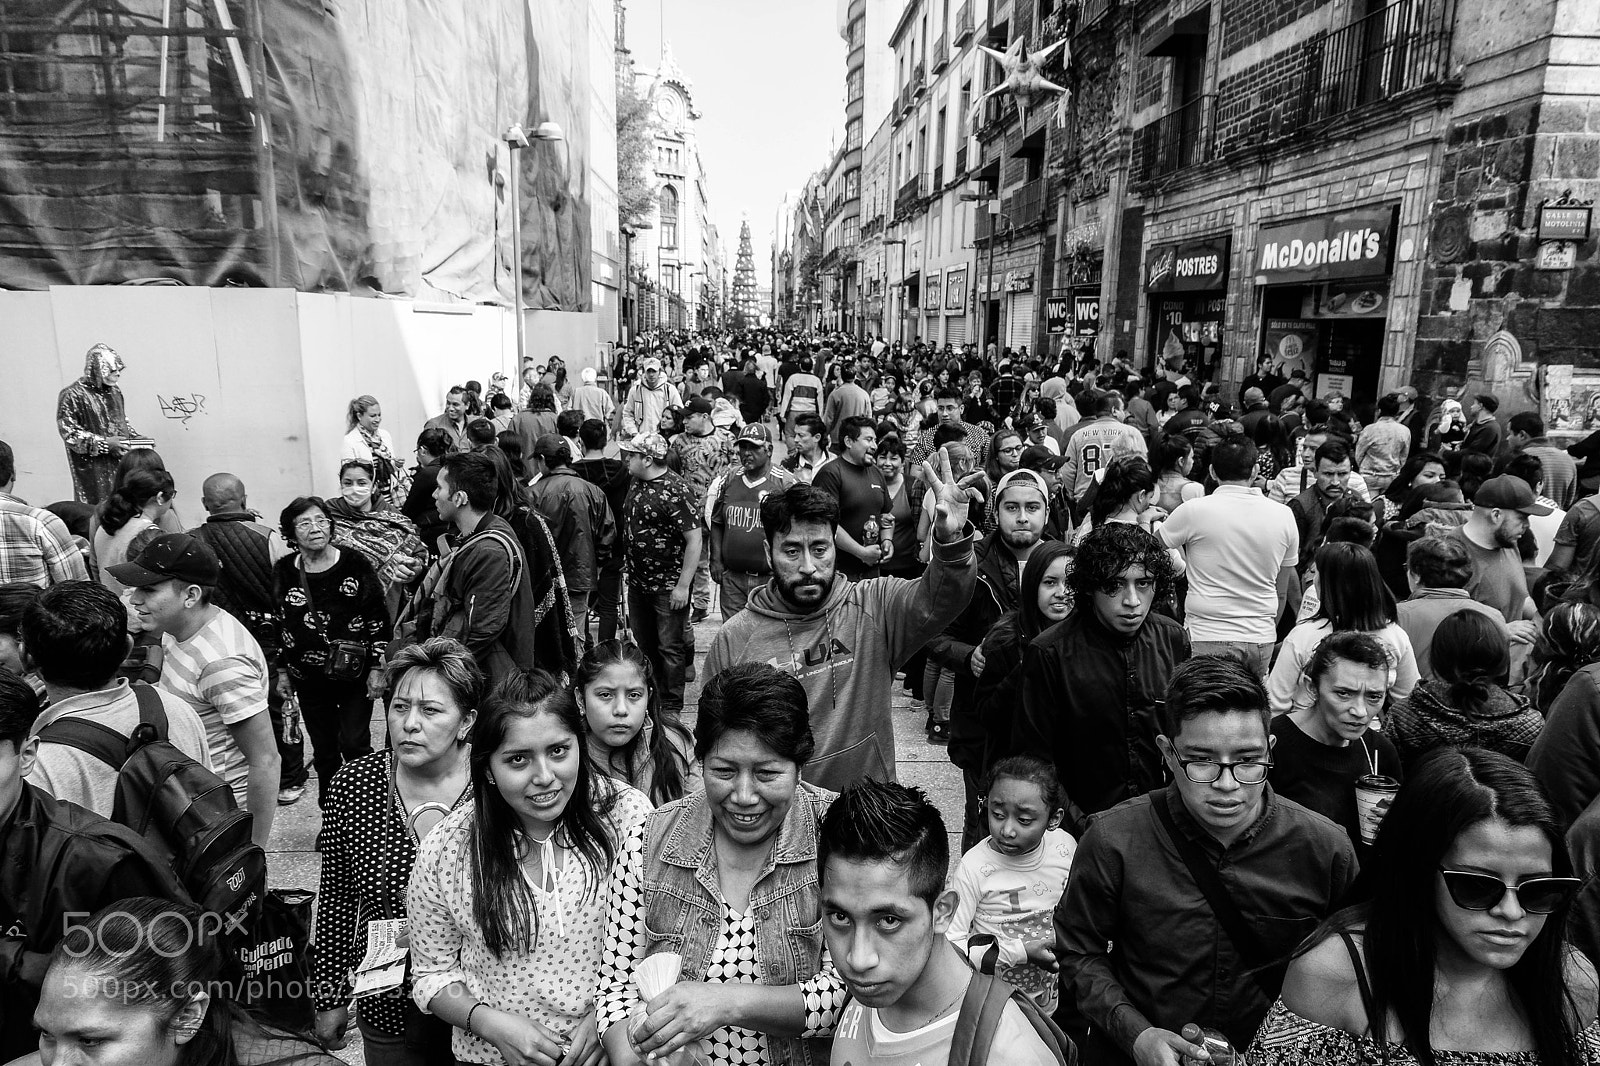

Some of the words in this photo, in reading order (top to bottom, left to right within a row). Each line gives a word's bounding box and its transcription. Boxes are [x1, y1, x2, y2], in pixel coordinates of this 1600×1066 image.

[1546, 212, 1570, 220] CALLE
[1261, 228, 1380, 270] McDonald's
[1175, 254, 1218, 277] POSTRES
[1048, 302, 1066, 319] WC
[1077, 302, 1099, 321] WC
[1163, 301, 1184, 310] CONO
[1166, 311, 1182, 325] $10
[743, 426, 759, 436] LA
[1082, 430, 1099, 438] NEW
[1103, 429, 1122, 437] YORK
[803, 638, 852, 667] UA
[240, 936, 294, 963] Cuidado
[244, 963, 257, 971] con
[256, 951, 293, 975] Perro
